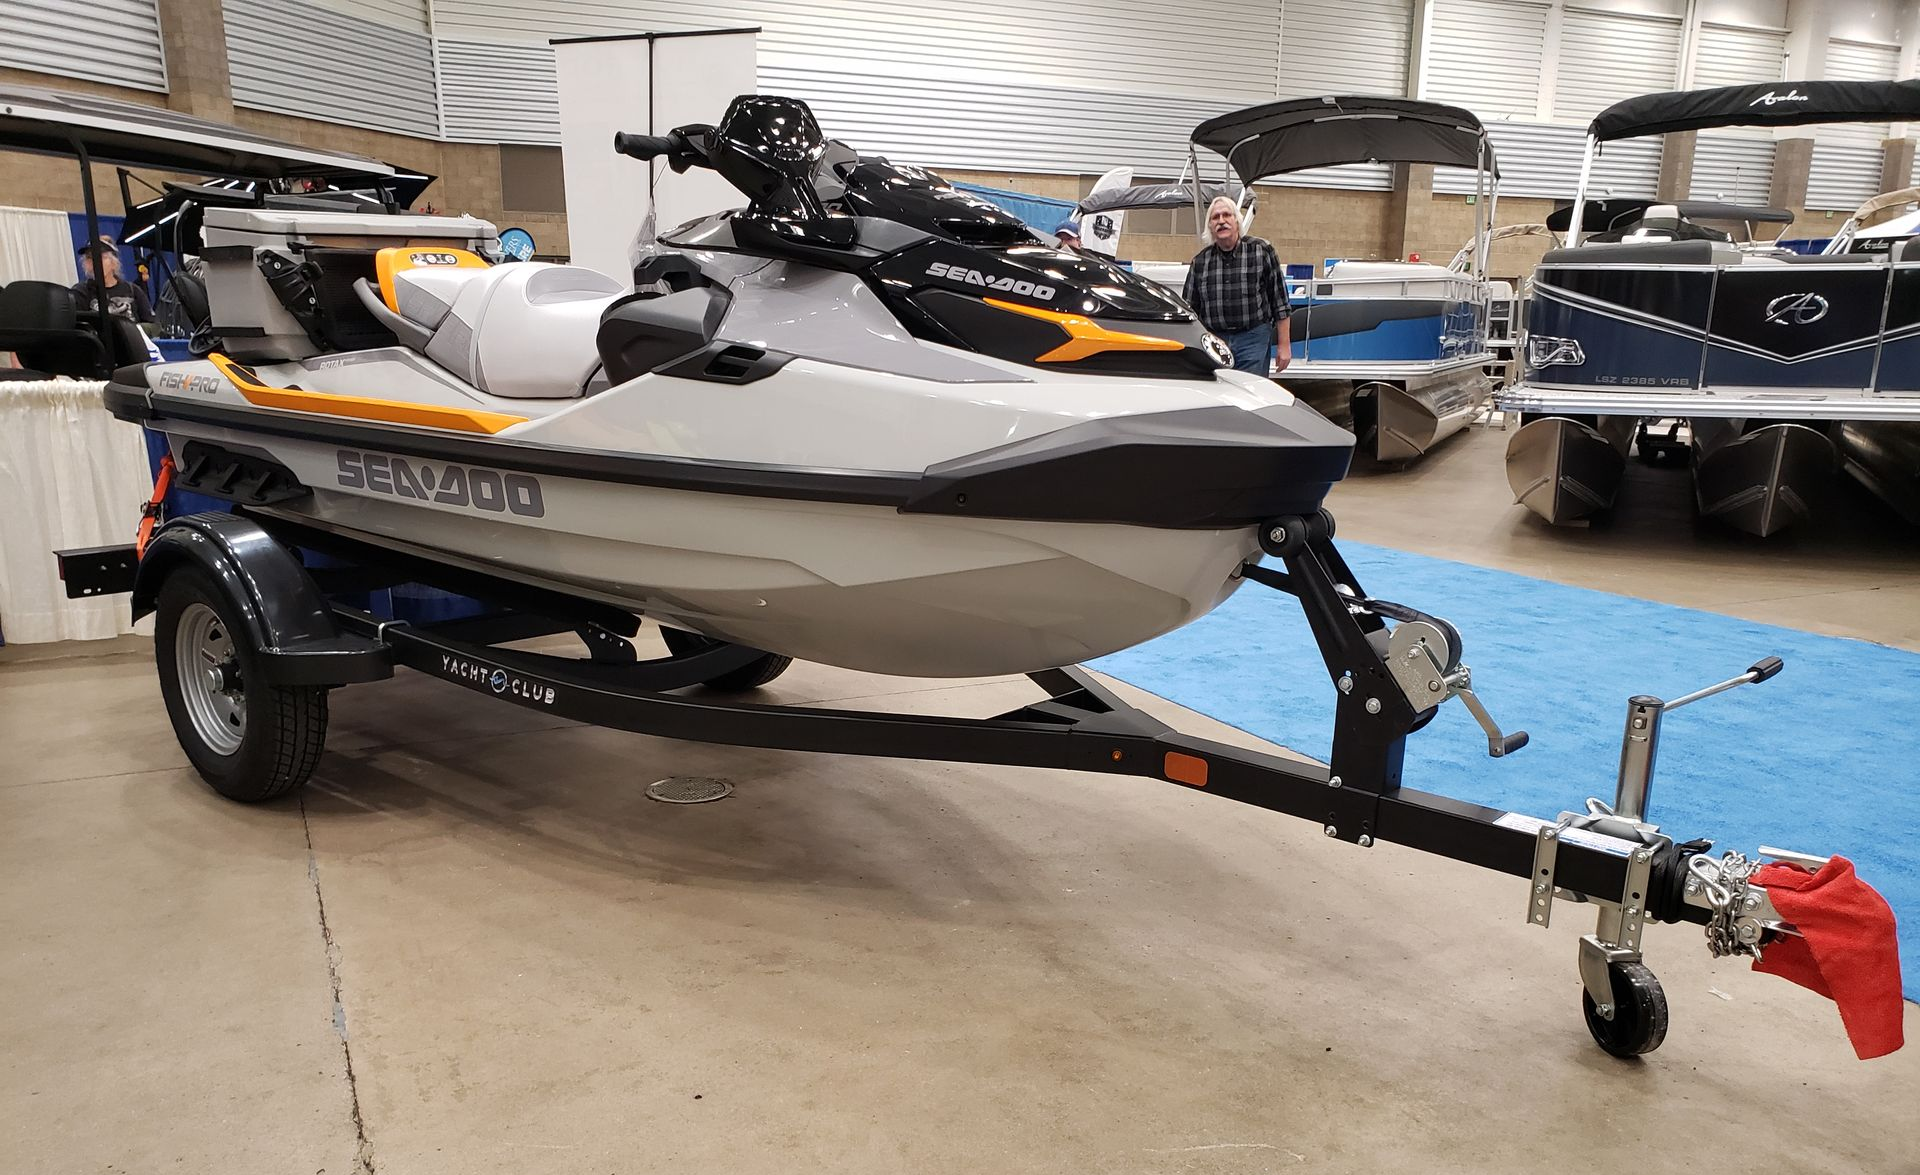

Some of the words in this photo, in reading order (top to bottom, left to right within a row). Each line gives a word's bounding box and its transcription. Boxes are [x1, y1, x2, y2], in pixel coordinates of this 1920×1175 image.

[1749, 89, 1809, 107] Avalon
[1595, 375, 1617, 384] LSZ
[1621, 376, 1656, 385] 2385
[442, 654, 489, 683] YACHT
[512, 678, 555, 705] CLUB
